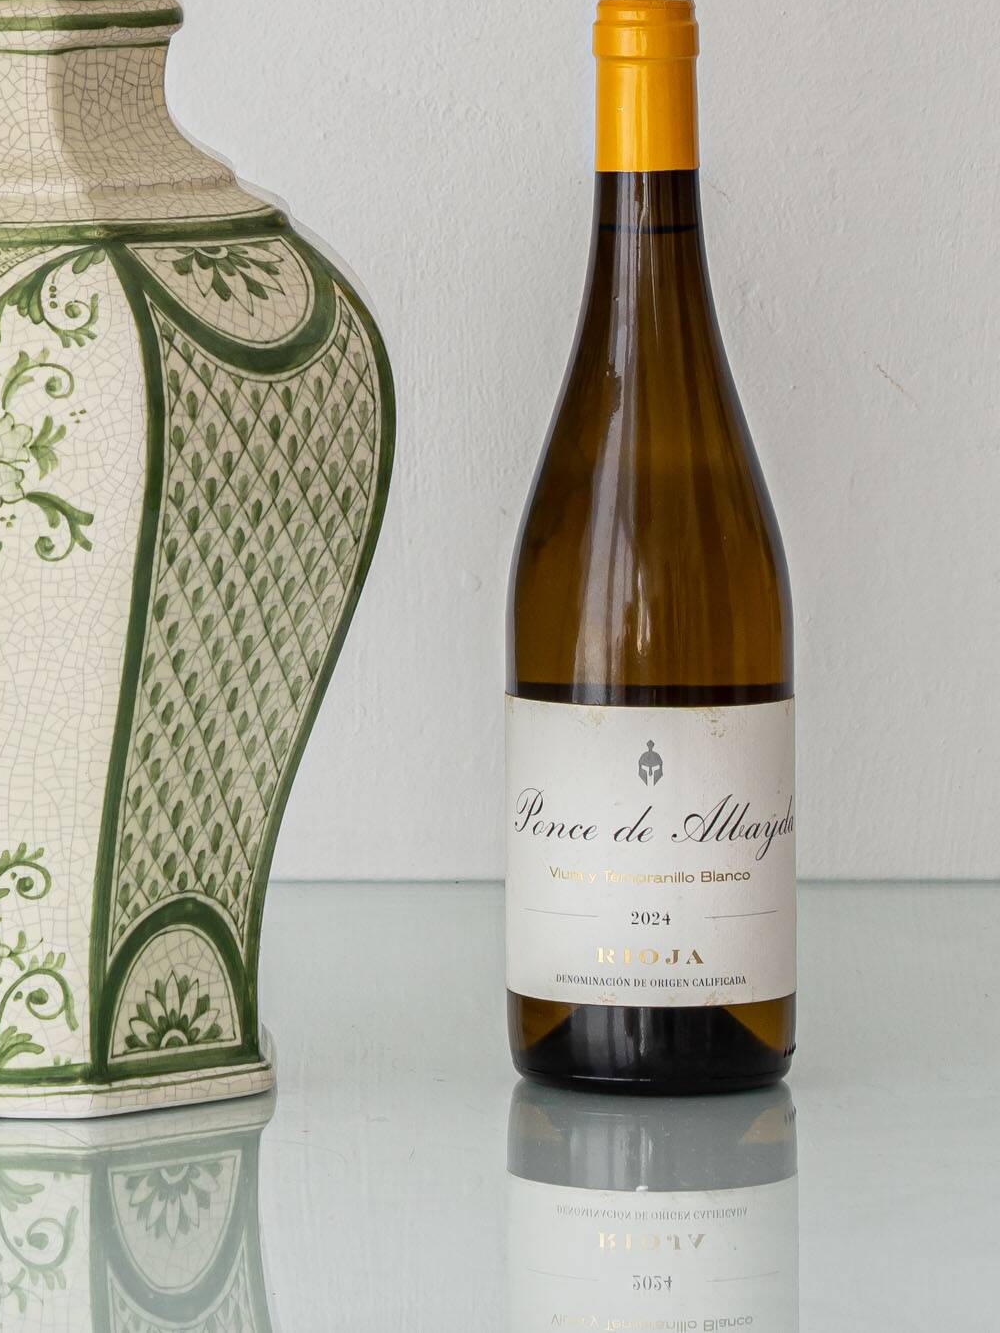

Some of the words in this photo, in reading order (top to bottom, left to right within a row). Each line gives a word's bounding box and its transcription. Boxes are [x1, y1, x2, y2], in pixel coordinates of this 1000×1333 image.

[514, 787, 599, 841] Ponce
[613, 805, 654, 843] de
[671, 793, 794, 861] Albayda
[587, 872, 597, 884] y
[701, 870, 751, 883] Blanco
[630, 911, 672, 926] 2024
[596, 946, 705, 965] RIOJA
[556, 973, 631, 987] DENOMINACIÓN
[633, 978, 648, 988] DE
[649, 977, 692, 988] ORIGEN
[692, 975, 747, 987] CALIFICADA
